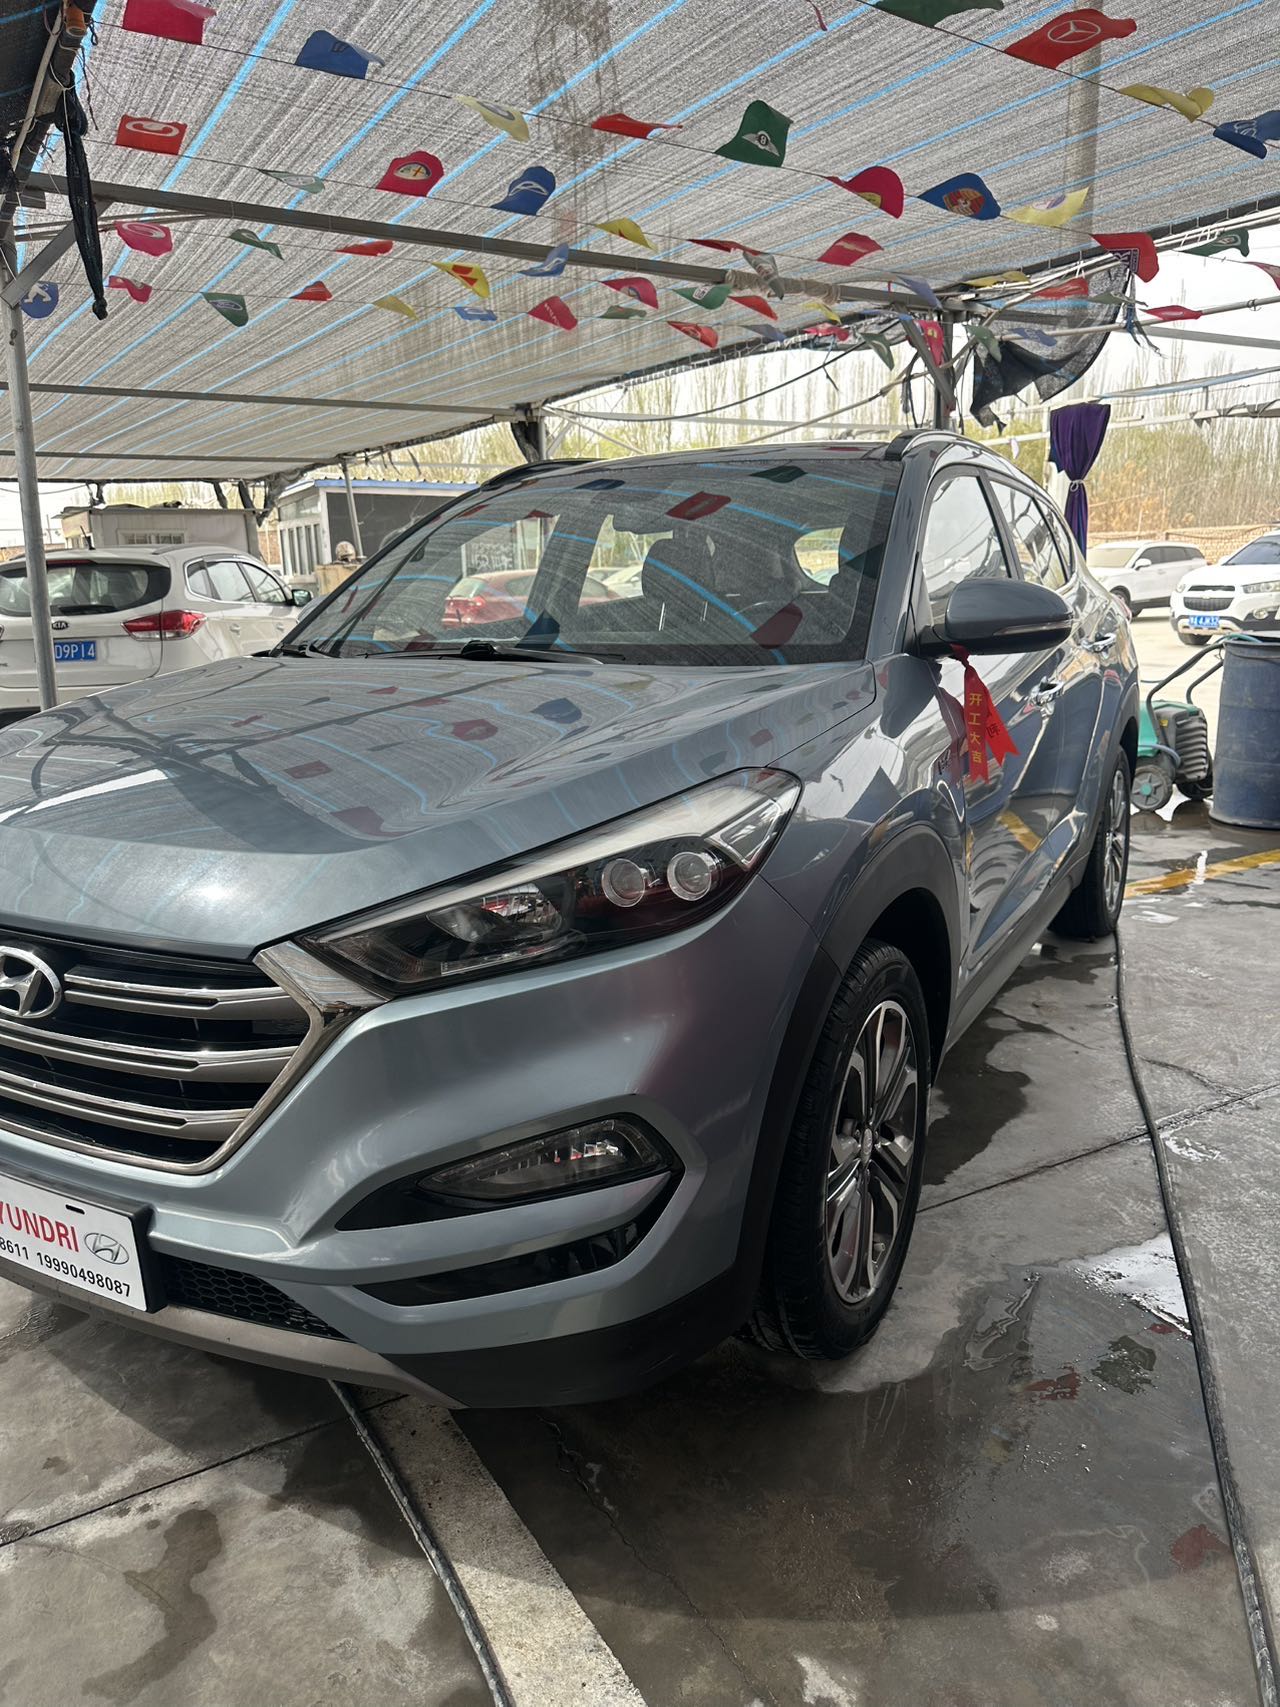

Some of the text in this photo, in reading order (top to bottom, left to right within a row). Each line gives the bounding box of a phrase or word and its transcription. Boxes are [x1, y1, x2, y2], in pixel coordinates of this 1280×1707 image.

[52, 621, 67, 629] KIA
[968, 693, 982, 763] 开工大吉
[36, 1252, 131, 1297] 19990498087
